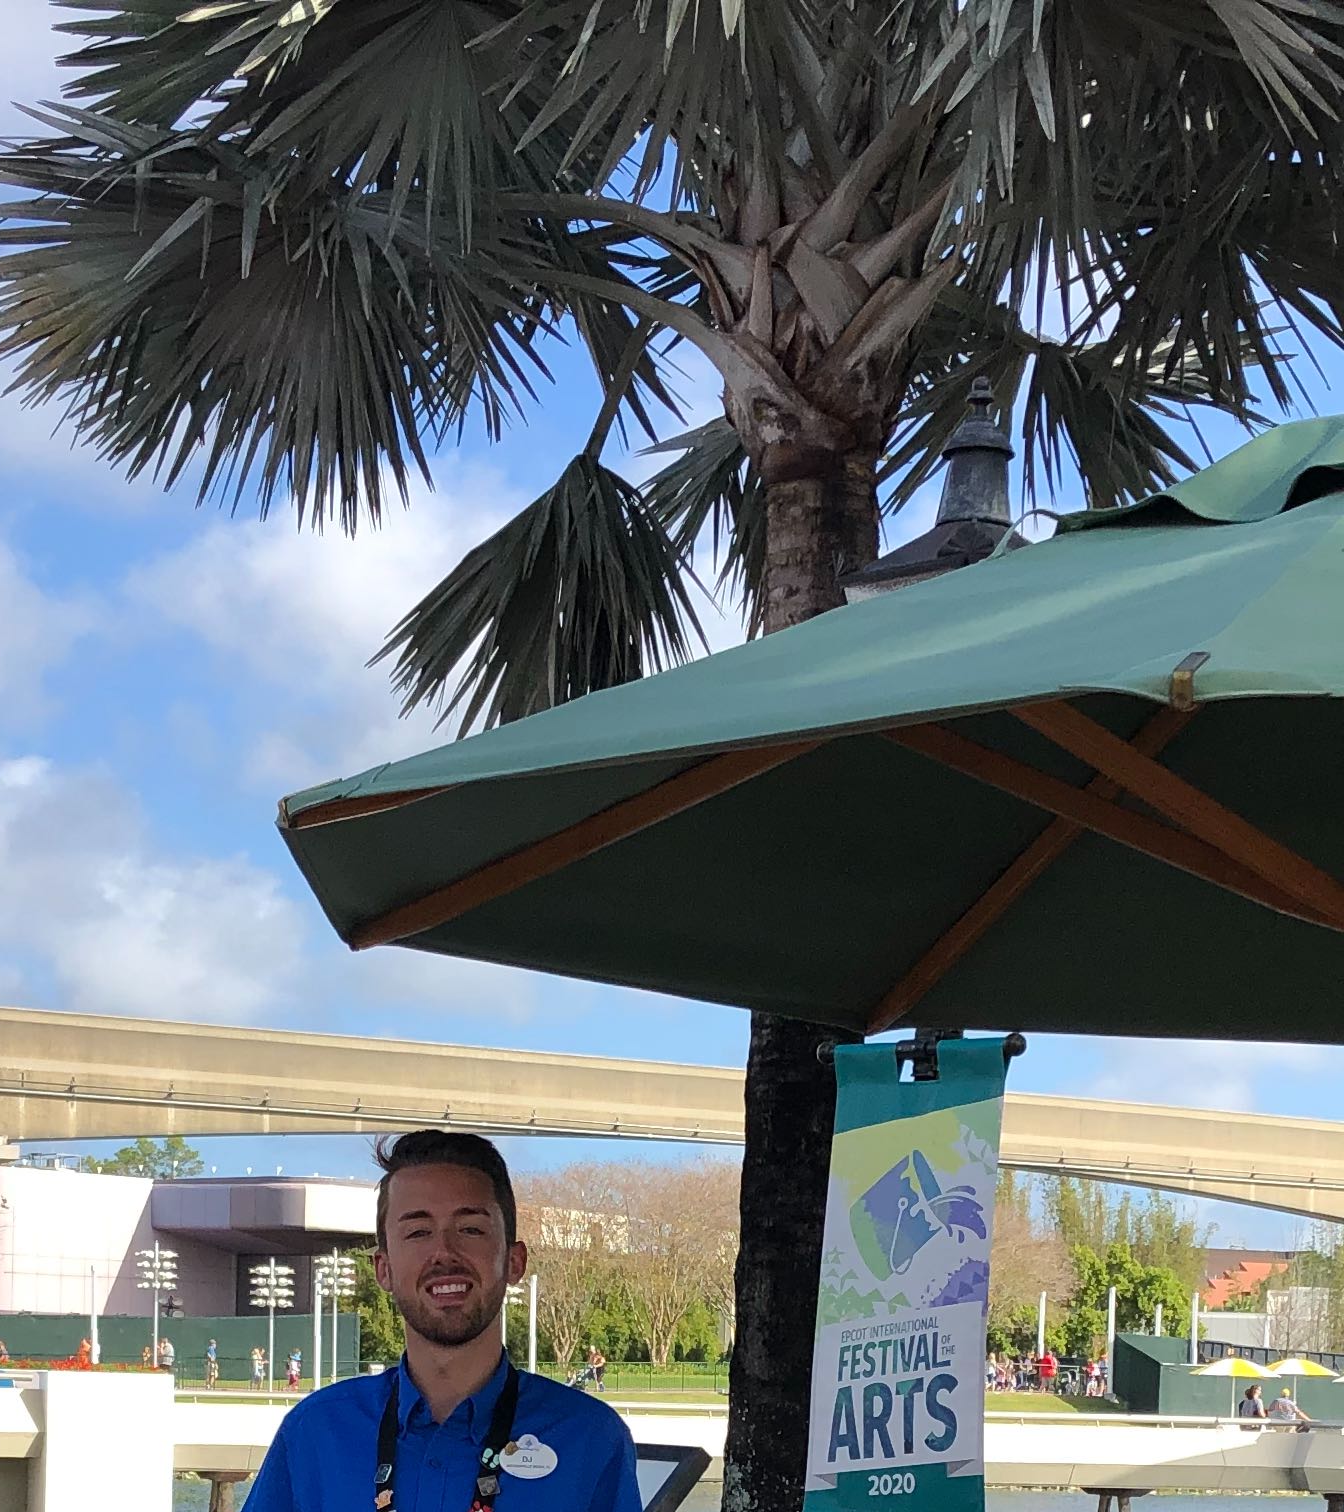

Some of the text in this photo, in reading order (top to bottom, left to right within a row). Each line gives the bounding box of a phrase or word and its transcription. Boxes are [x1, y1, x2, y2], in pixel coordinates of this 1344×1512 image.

[841, 1316, 939, 1343] EPCOT INTERNATIONAL
[941, 1334, 952, 1345] OF
[837, 1331, 952, 1382] FESTIVAL
[941, 1345, 956, 1356] THE
[827, 1373, 959, 1463] ARTS
[522, 1455, 533, 1463] DJ
[867, 1472, 916, 1496] 2020
